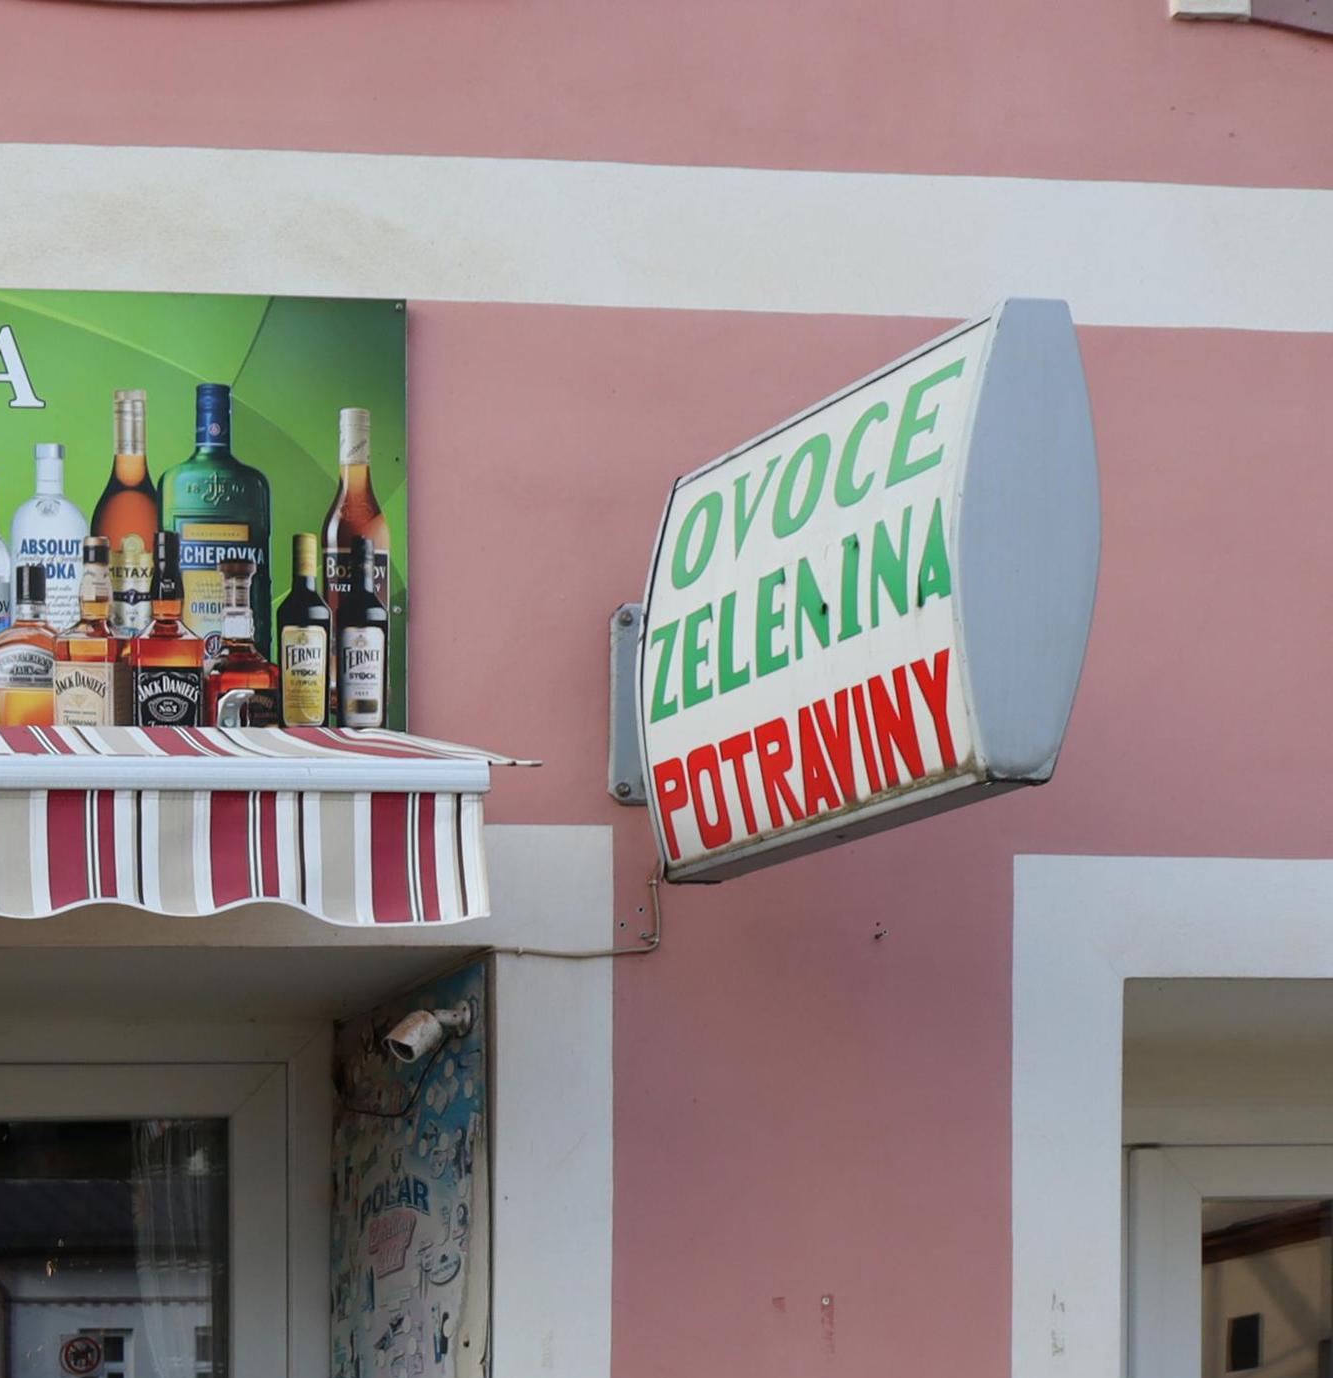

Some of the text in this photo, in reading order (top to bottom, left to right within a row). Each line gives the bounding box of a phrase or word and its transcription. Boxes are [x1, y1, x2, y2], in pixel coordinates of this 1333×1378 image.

[671, 356, 967, 591] OVOCE
[20, 538, 82, 556] ABSOLUT
[649, 497, 953, 724] ZELENINA
[285, 645, 322, 672] FERNET
[343, 647, 381, 674] FERNET
[55, 676, 74, 696] JACK
[137, 680, 162, 703] JACK
[653, 648, 957, 861] POTRAVINY
